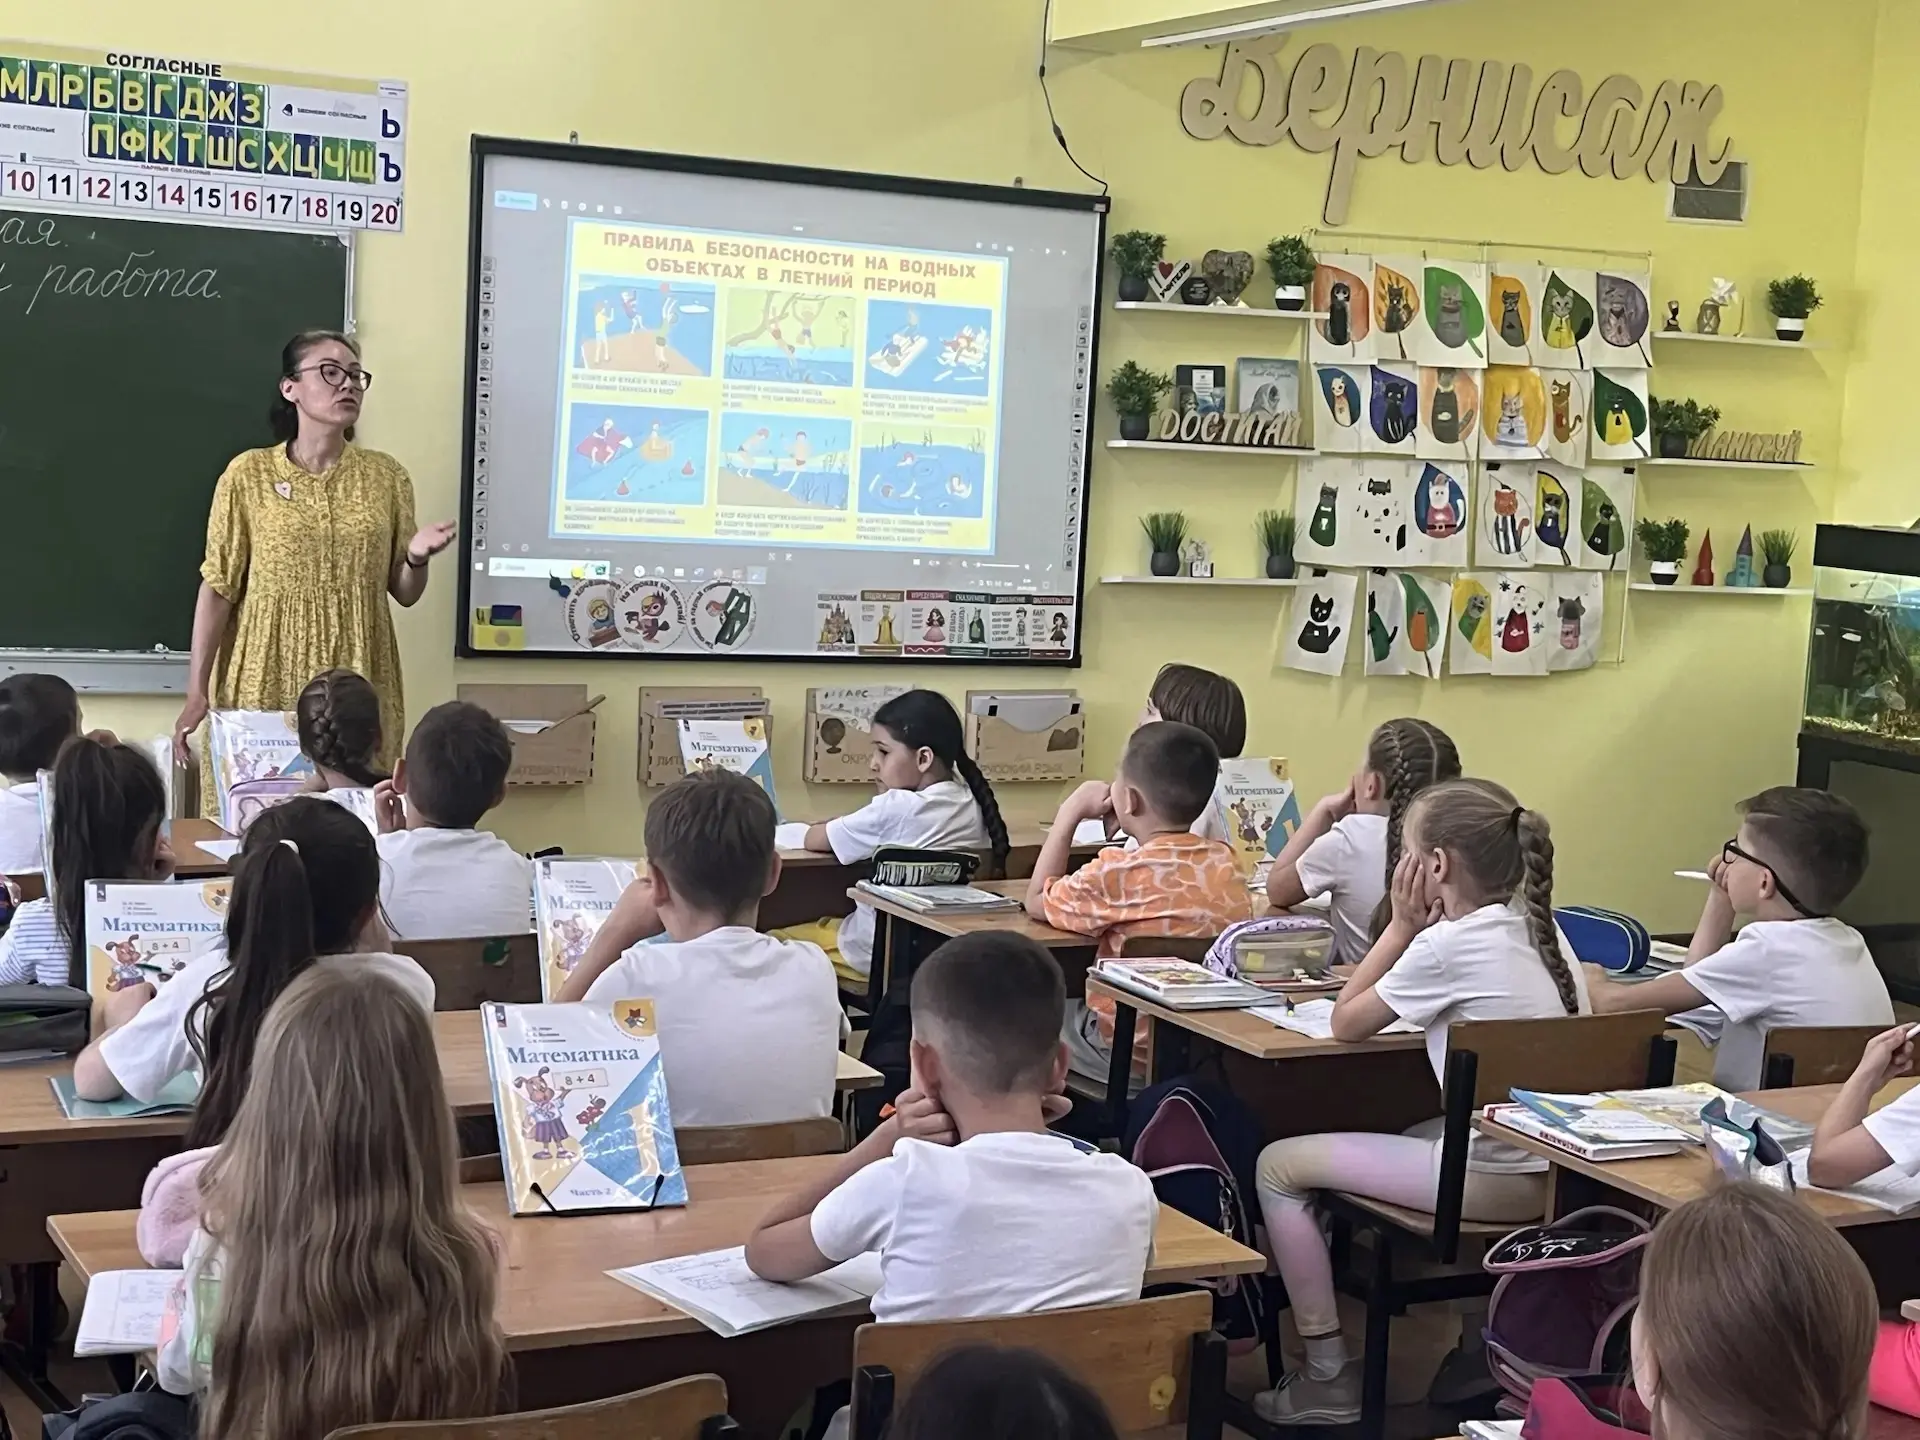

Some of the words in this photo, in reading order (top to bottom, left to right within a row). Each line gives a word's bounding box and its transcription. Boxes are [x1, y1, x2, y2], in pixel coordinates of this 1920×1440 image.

[106, 53, 222, 78] СОГЛАСНЫЕ
[1180, 31, 1733, 226] Вернисаж
[7, 169, 35, 192] 10
[48, 174, 71, 195] 11
[83, 177, 111, 199] 12
[120, 180, 148, 202] 13
[157, 184, 185, 205] 14
[194, 187, 221, 208] 15
[230, 190, 257, 212] 16
[266, 194, 293, 214] 17
[302, 197, 328, 218] 18
[337, 201, 363, 221] 19
[371, 204, 398, 224] 20
[604, 232, 694, 253] ПРАВИЛА
[706, 241, 854, 267] БЕЗОПАСНОСТИ
[865, 256, 888, 271] НА
[900, 259, 976, 278] ВОДНЫХ
[26, 250, 221, 314] работа.
[646, 257, 745, 279] ОБЪЕКТАХ
[757, 267, 768, 280] В
[779, 269, 853, 289] ЛЕТНИЙ
[864, 277, 936, 298] ПЕРИОД
[691, 741, 757, 753] Математика
[1224, 785, 1285, 796] Математика
[102, 917, 222, 932] Математика
[507, 1046, 640, 1064] Математика
